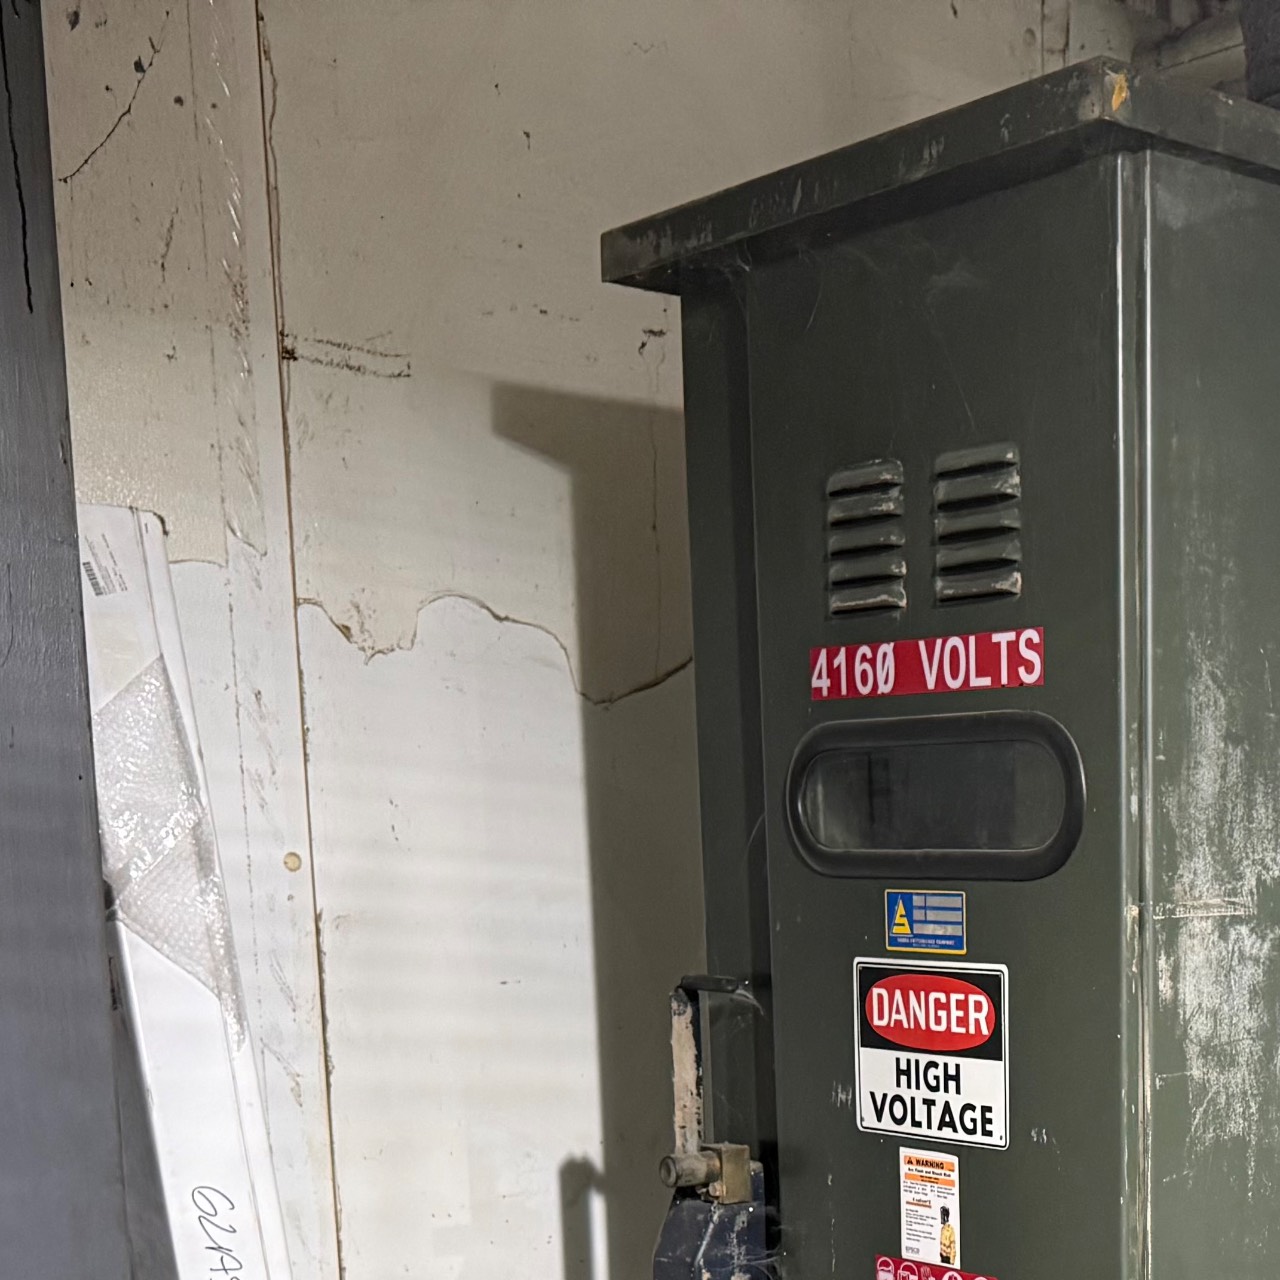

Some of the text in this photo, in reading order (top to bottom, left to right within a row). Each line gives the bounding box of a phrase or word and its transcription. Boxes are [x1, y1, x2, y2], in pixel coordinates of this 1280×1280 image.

[918, 628, 1042, 690] VOLTS
[872, 987, 989, 1036] DANGER
[895, 1057, 961, 1096] HIGH
[869, 1091, 993, 1138] VOLTAGE
[915, 1158, 945, 1170] WARNING
